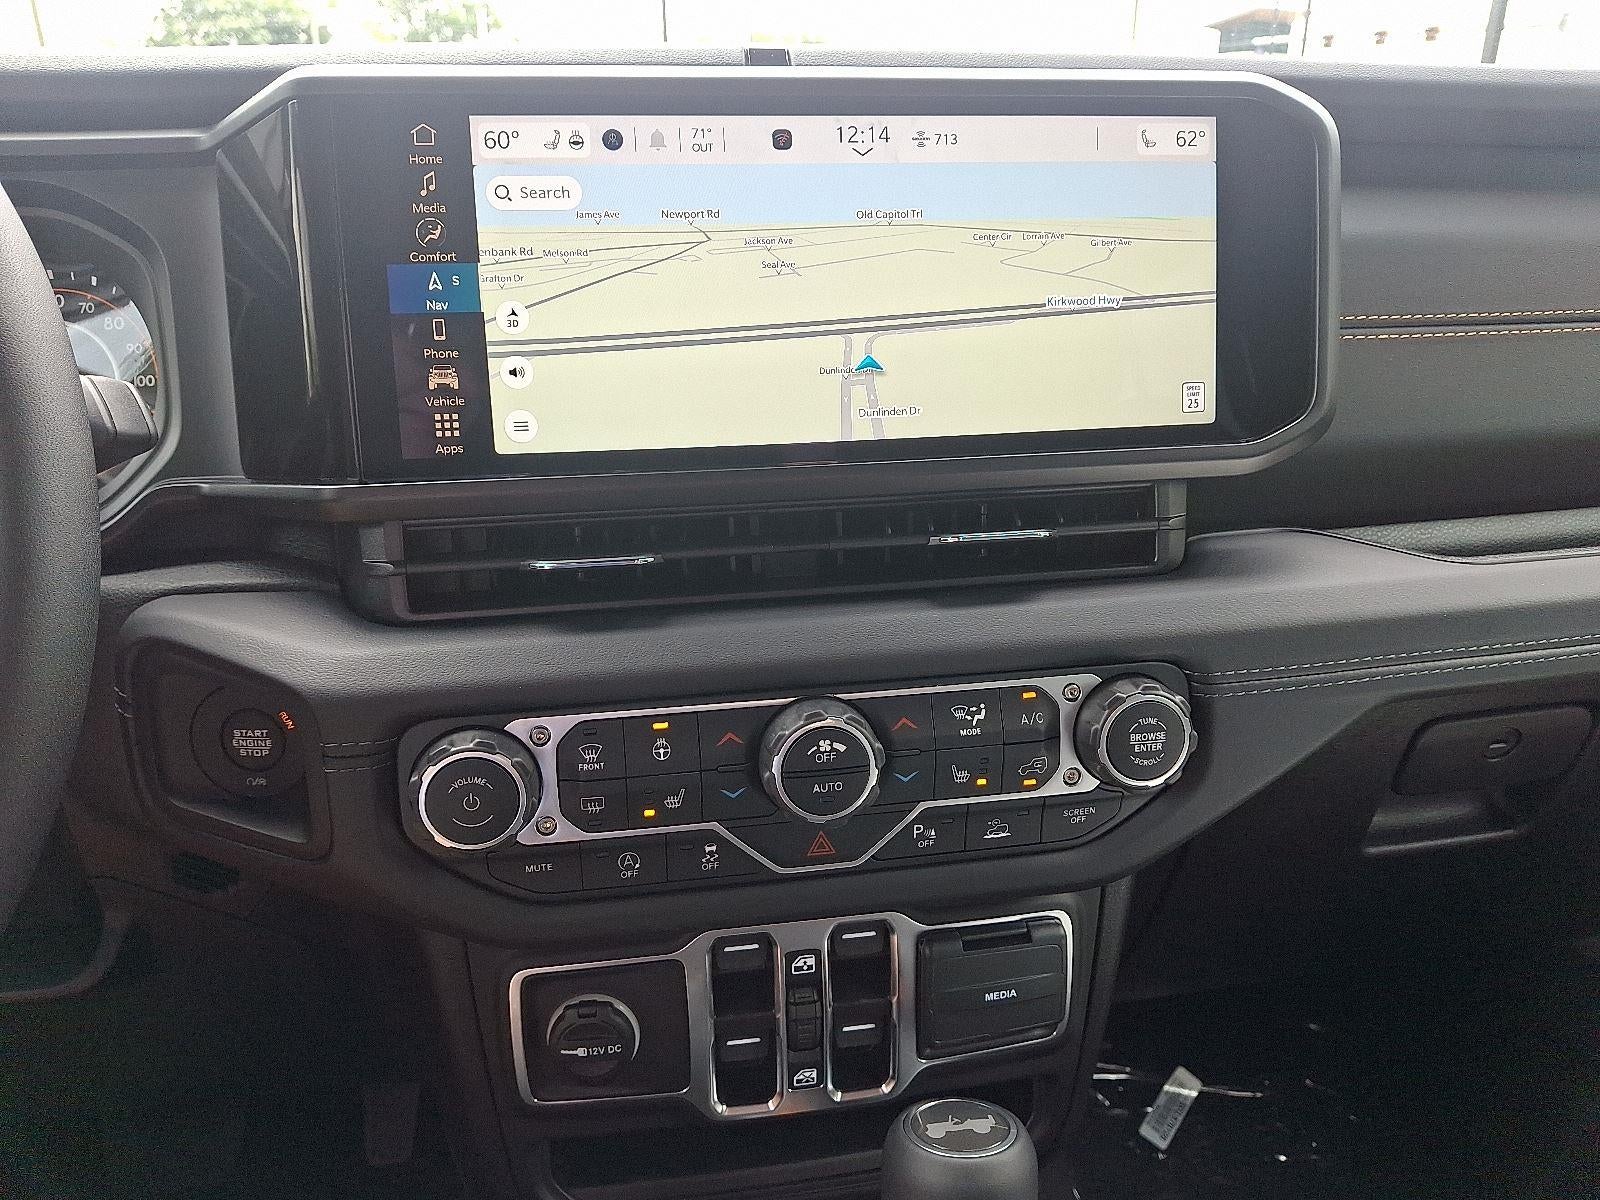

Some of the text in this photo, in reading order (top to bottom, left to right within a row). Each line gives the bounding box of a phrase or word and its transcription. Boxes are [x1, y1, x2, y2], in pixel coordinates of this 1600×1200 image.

[691, 127, 712, 139] 71°
[837, 125, 891, 144] 12:14
[483, 130, 520, 150] 60°
[934, 133, 958, 146] 713
[1176, 130, 1206, 148] 62°
[692, 143, 713, 153] OUT
[409, 154, 443, 165] Home
[519, 186, 571, 200] Search
[412, 202, 446, 214] Media
[576, 209, 620, 221] James Ave
[661, 208, 720, 221] Newport Rd
[856, 208, 874, 219] Old
[875, 208, 909, 221] Capitol
[744, 236, 794, 246] Jackson Ave
[972, 232, 1012, 243] Center Cir
[1022, 231, 1065, 241] Lorrain Ave
[1090, 239, 1116, 247] Gibert
[519, 246, 534, 256] Rd
[576, 248, 589, 257] Rd
[410, 252, 457, 263] Comfort
[761, 260, 779, 269] Seal
[452, 274, 460, 286] S
[513, 273, 524, 282] Dr
[426, 300, 449, 311] Nav
[1046, 295, 1121, 307] Kirkwood Hwy
[78, 302, 95, 314] 70
[104, 317, 125, 330] 80
[506, 319, 519, 328] 3D
[423, 348, 460, 360] Phone
[424, 395, 465, 407] Vehicle
[1187, 398, 1199, 409] 25
[858, 406, 922, 419] Dunlinden Dr
[435, 443, 464, 456] Apps
[279, 711, 295, 730] RUN
[1021, 711, 1044, 726] A/C
[1138, 716, 1159, 726] TUNE
[233, 729, 269, 737] START
[959, 728, 982, 737] MODE
[1130, 731, 1167, 742] BROWSE
[232, 739, 272, 747] ENGINE
[1134, 743, 1163, 753] ENTER
[239, 749, 270, 757] STOP
[815, 753, 837, 763] OFF
[578, 762, 605, 771] FRONT
[1133, 756, 1162, 767] SCROLL
[452, 776, 488, 789] VOLUME
[812, 782, 843, 793] AUTO
[1063, 806, 1096, 817] SCREEN
[1070, 815, 1087, 824] OFF
[918, 840, 935, 848] OFF
[525, 864, 553, 873] MUTE
[701, 861, 720, 871] OFF
[620, 870, 639, 879] OFF
[984, 988, 1017, 1002] MEDIA
[588, 1044, 622, 1056] 12V DC
